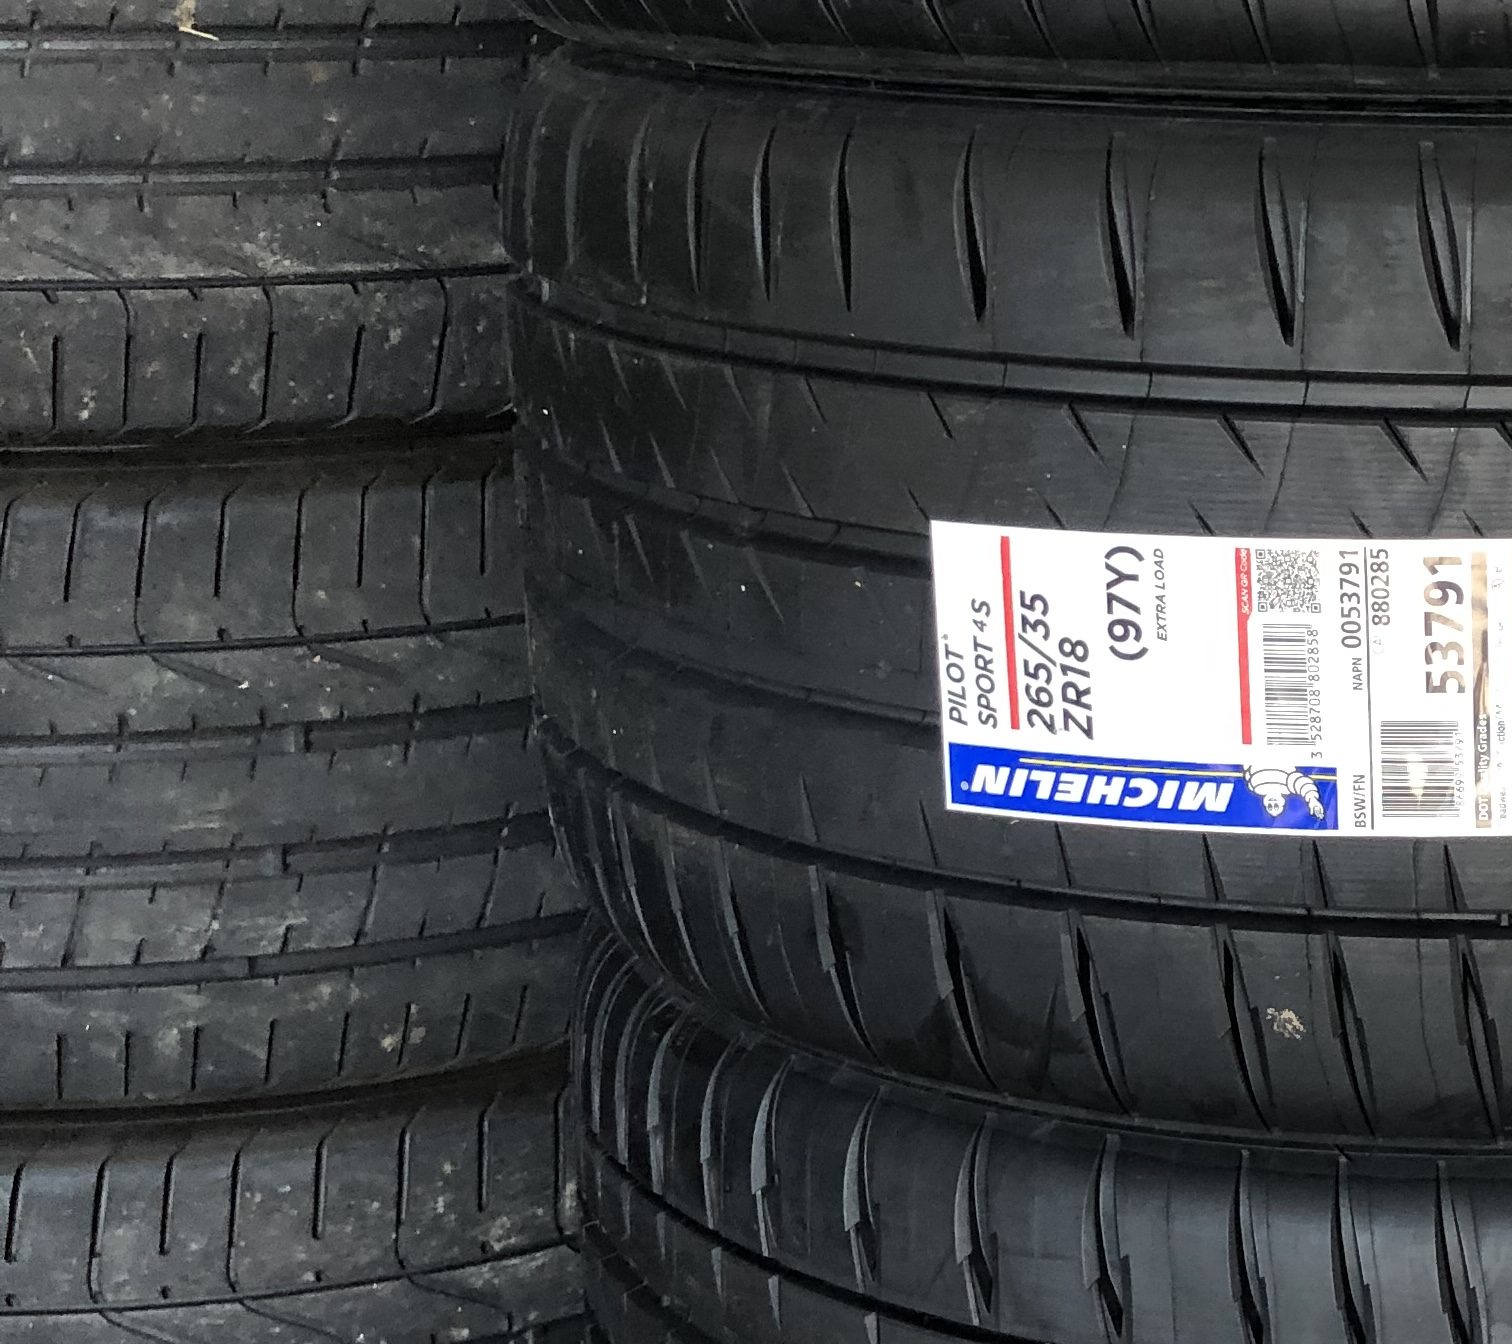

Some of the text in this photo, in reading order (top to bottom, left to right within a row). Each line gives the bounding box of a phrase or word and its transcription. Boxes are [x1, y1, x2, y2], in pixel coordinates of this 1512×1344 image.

[1104, 545, 1149, 661] (97Y)
[1153, 548, 1168, 642] EXTRA LOAD
[1369, 548, 1391, 627] 880285
[1422, 556, 1467, 695] 53791
[943, 645, 968, 726] PILOT
[972, 636, 998, 730] SPORT
[1017, 590, 1059, 735] 265/35
[1058, 637, 1094, 740] ZR18
[1338, 549, 1367, 828] BSW/FN NAPN 0053791
[970, 763, 1235, 812] MICHELIN
[1477, 714, 1489, 821] DOT Grades
